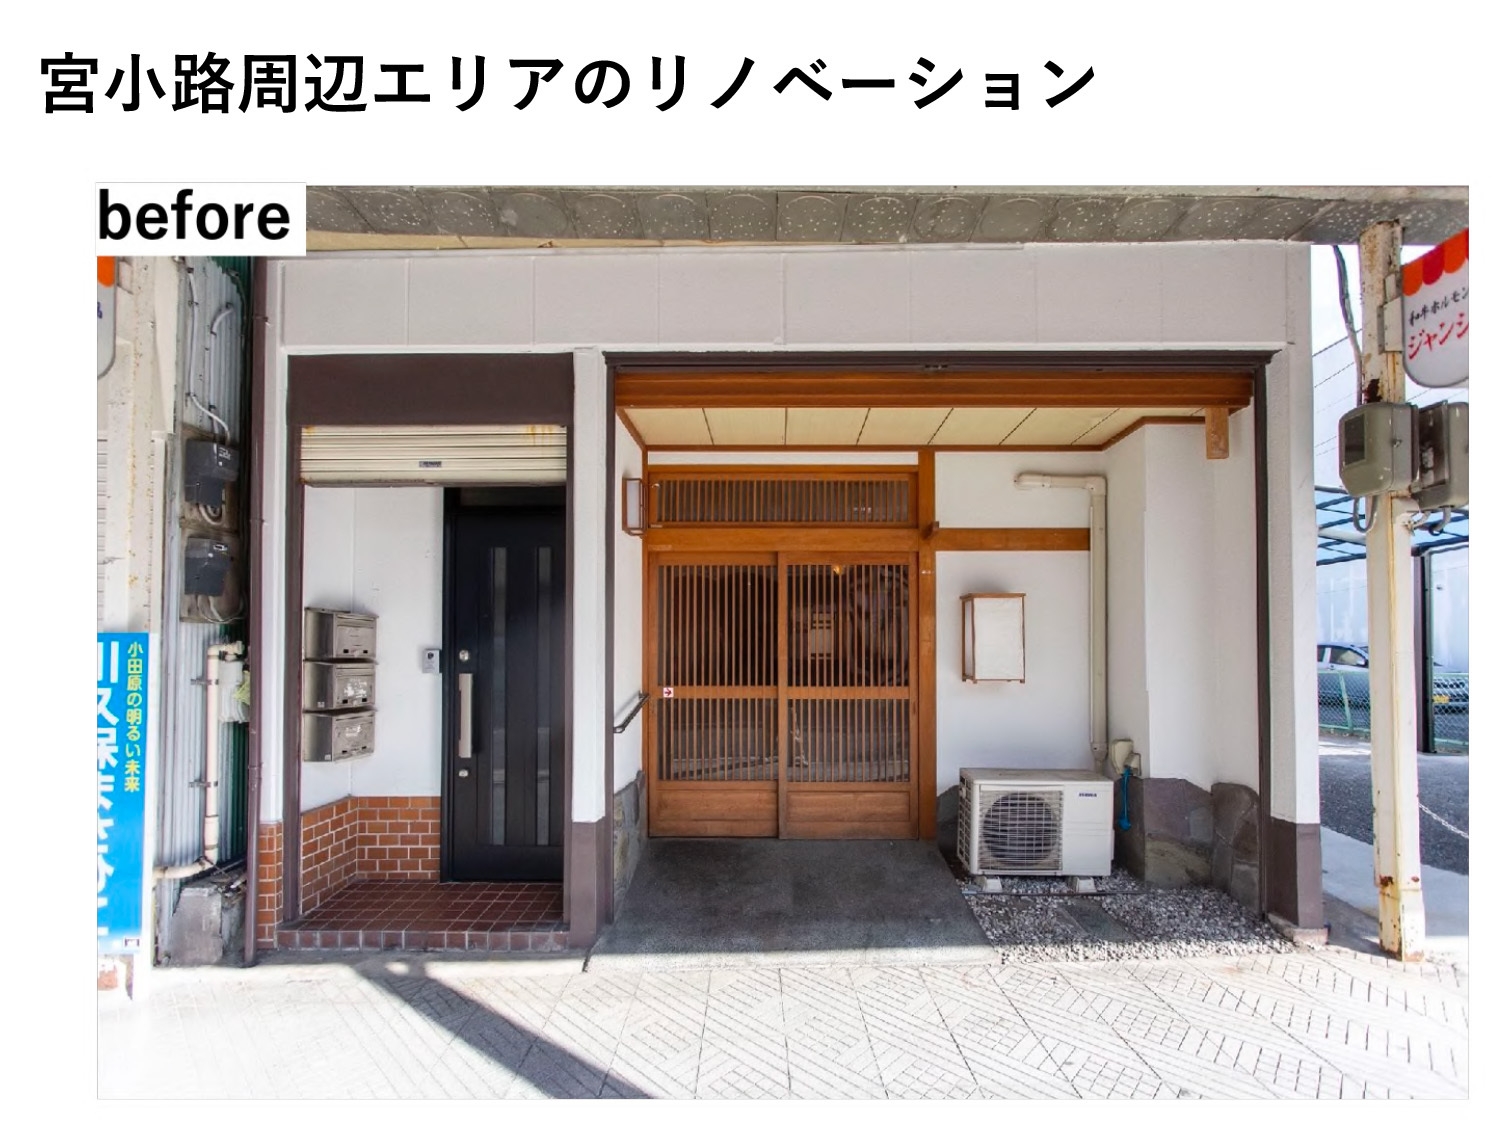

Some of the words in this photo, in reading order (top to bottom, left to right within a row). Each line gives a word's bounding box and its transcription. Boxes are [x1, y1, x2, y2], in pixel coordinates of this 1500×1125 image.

[124, 641, 144, 793] 小田原の明るい未来
